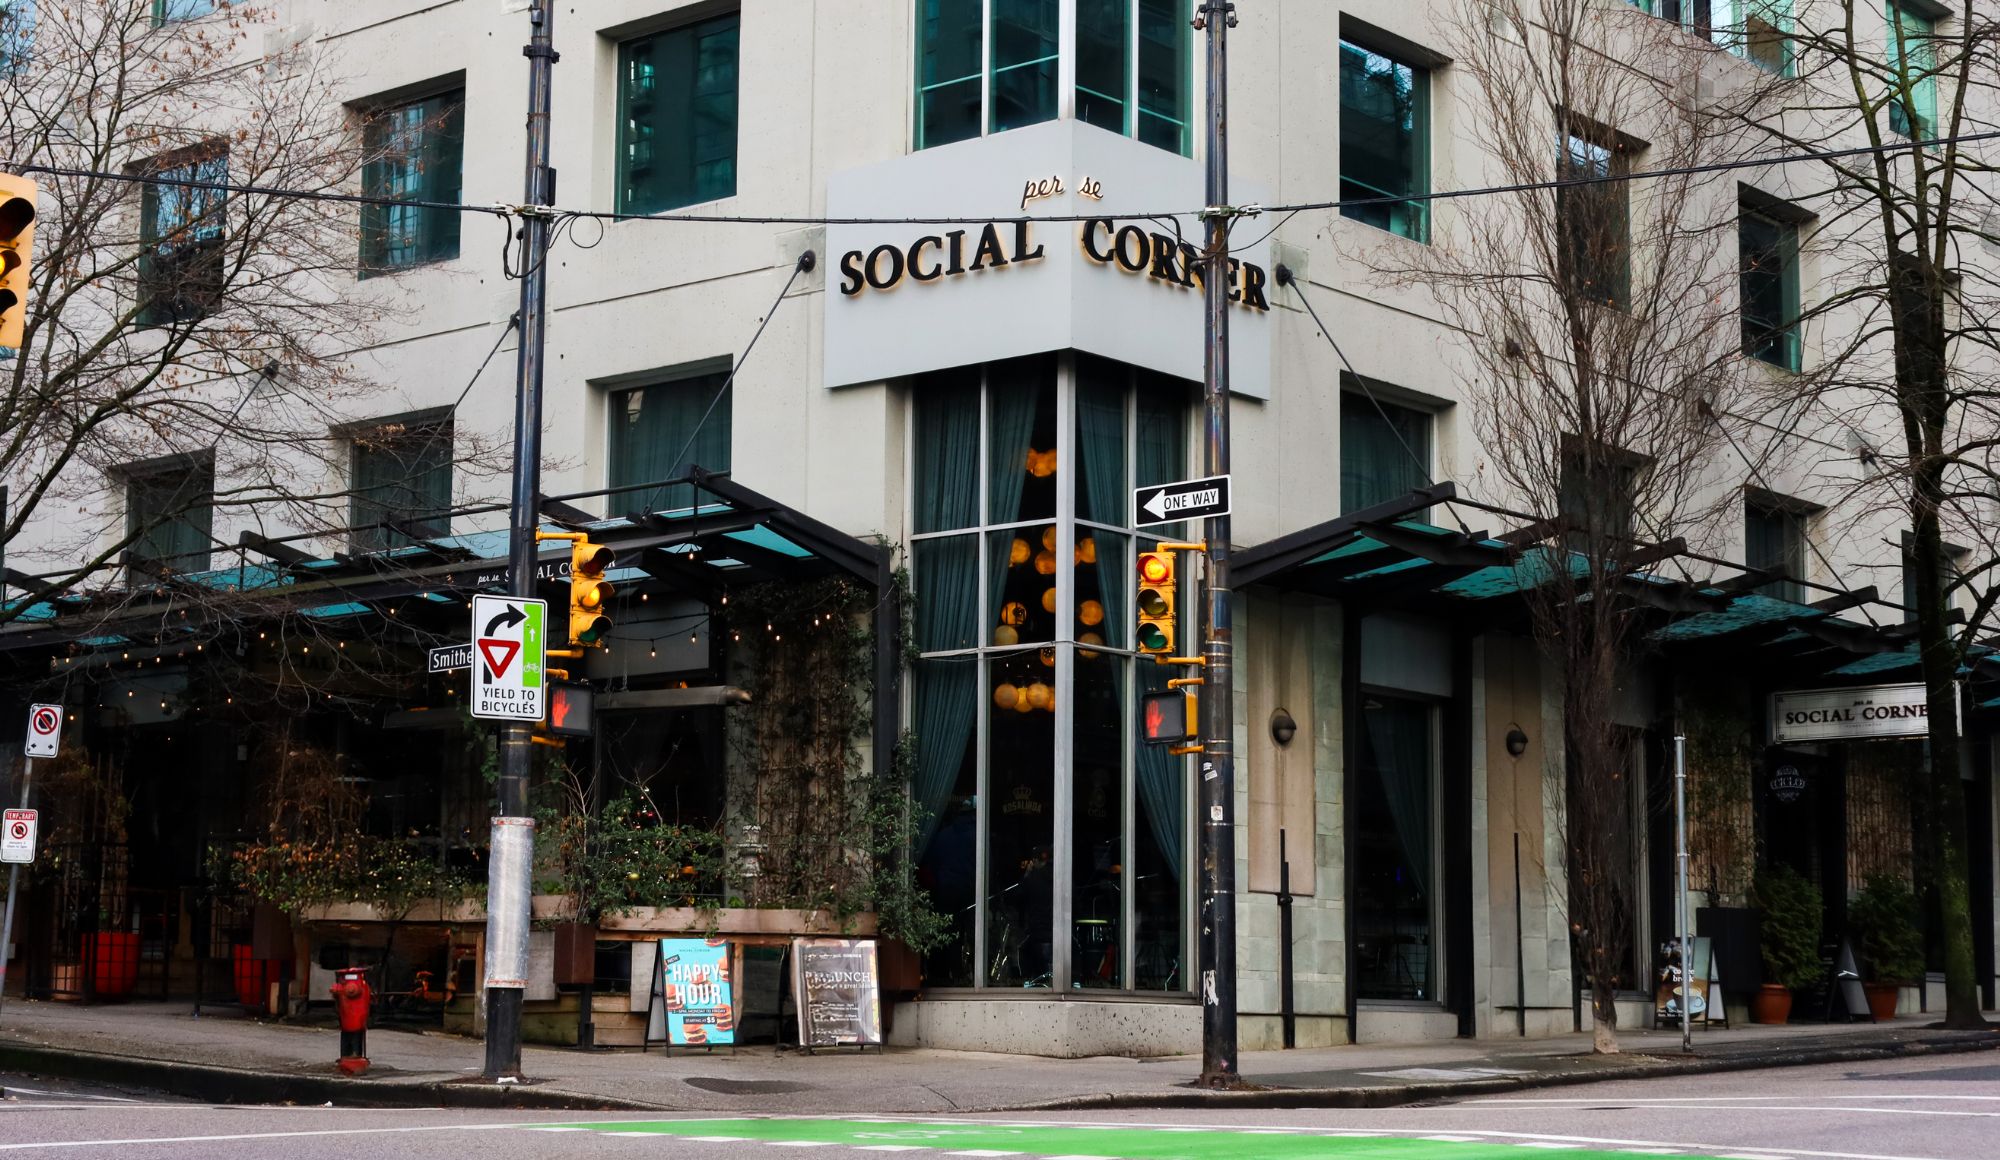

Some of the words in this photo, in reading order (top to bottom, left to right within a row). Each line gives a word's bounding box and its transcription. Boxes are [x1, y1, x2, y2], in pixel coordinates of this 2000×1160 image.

[1021, 175, 1063, 209] per
[1078, 177, 1103, 200] se
[840, 217, 1044, 296] SOCIAL
[1164, 495, 1187, 509] ONE
[1193, 490, 1216, 505] WAY
[433, 649, 472, 668] Smithe
[483, 688, 515, 699] YIELD
[521, 690, 535, 700] TO
[482, 701, 535, 714] BICYCLES
[1786, 709, 1855, 724] SOCIAL
[1862, 704, 1928, 720] CORNE
[672, 963, 720, 982] HAPPY
[1673, 974, 1694, 982] brk
[675, 983, 722, 1005] HOUR
